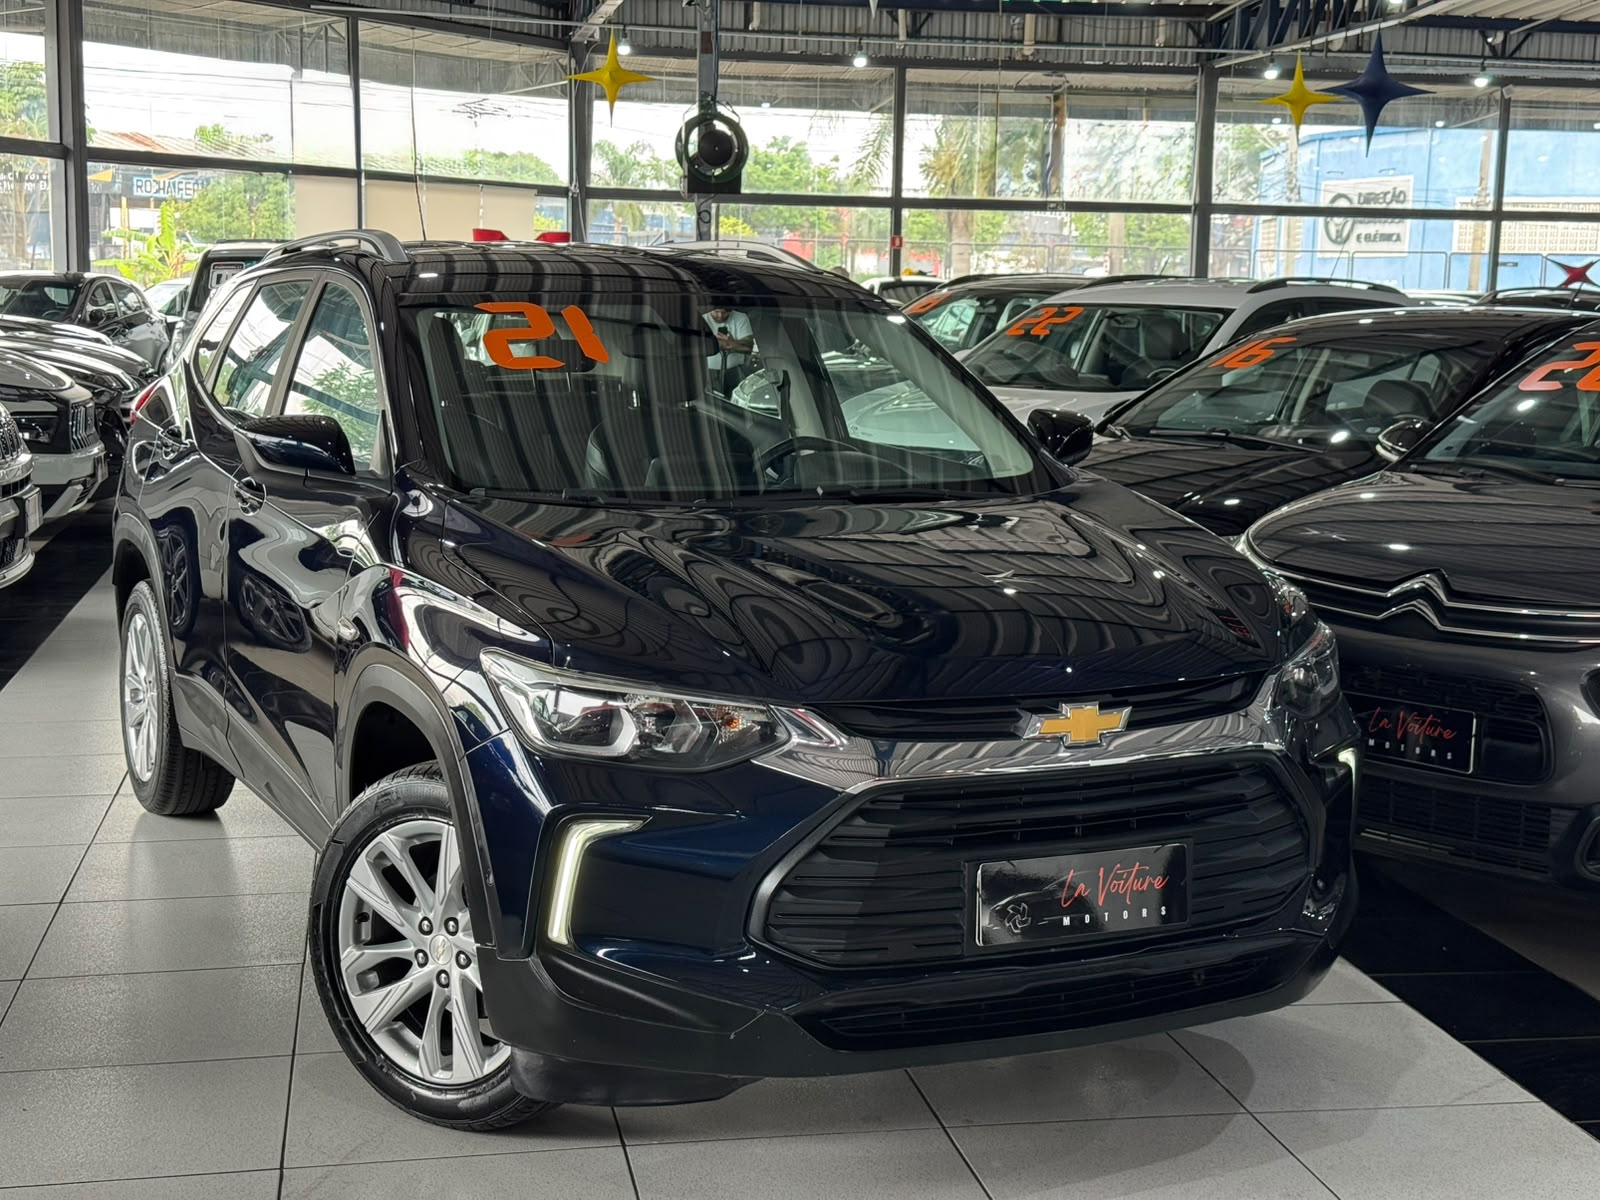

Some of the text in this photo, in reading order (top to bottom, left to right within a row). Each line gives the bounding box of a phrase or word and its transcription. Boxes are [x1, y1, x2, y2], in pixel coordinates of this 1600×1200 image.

[135, 179, 175, 195] ROCHA
[474, 301, 609, 370] 21
[1007, 306, 1084, 336] 22
[1207, 336, 1297, 368] 16
[1368, 706, 1457, 745] La Voiture
[1368, 738, 1453, 760] MOTORS
[1060, 861, 1169, 908] La Voiture
[1062, 905, 1168, 926] MOTORS
